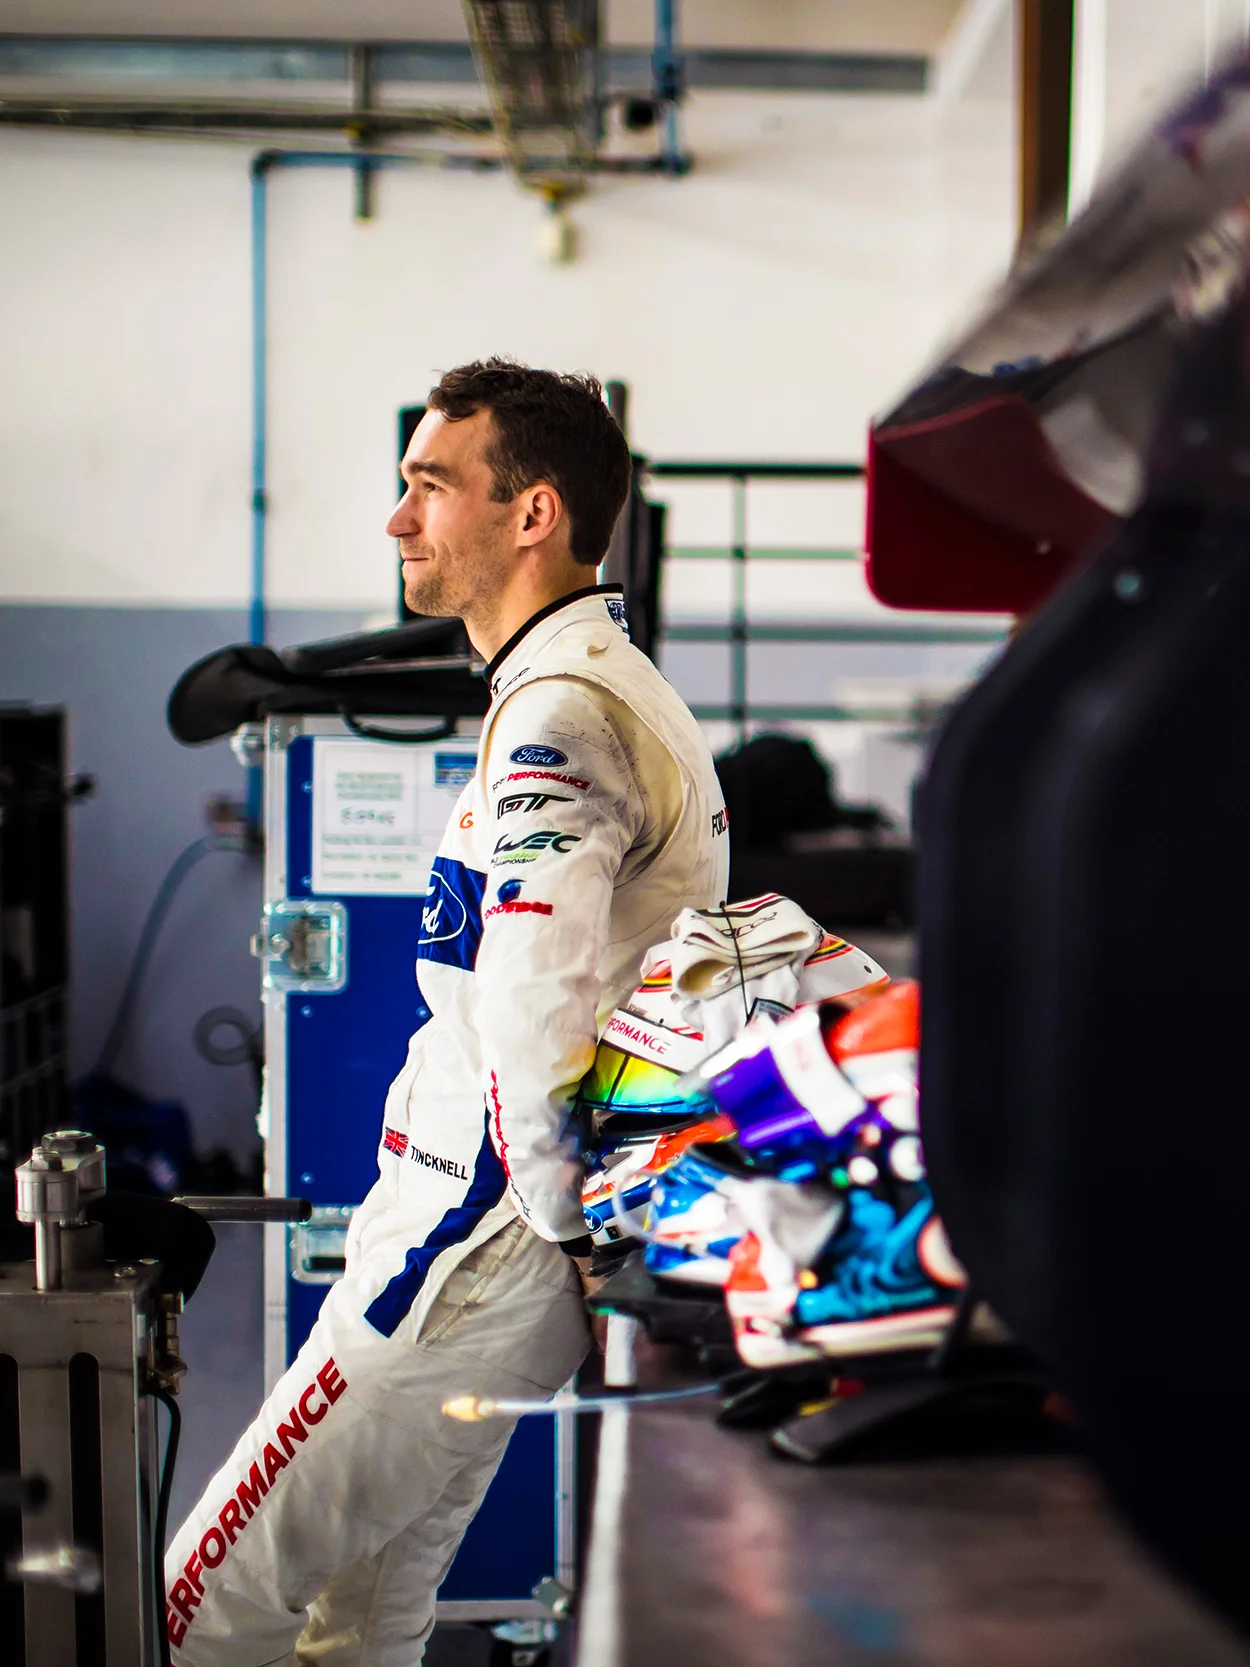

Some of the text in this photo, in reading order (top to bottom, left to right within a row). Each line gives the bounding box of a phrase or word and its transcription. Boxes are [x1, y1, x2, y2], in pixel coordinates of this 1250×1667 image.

[516, 748, 556, 764] Ford
[507, 771, 591, 791] PERFORMANCE
[497, 792, 576, 820] GT
[493, 831, 582, 855] WEC
[411, 1145, 468, 1180] TINCKNELL
[165, 1357, 348, 1650] ERFORMANCE
